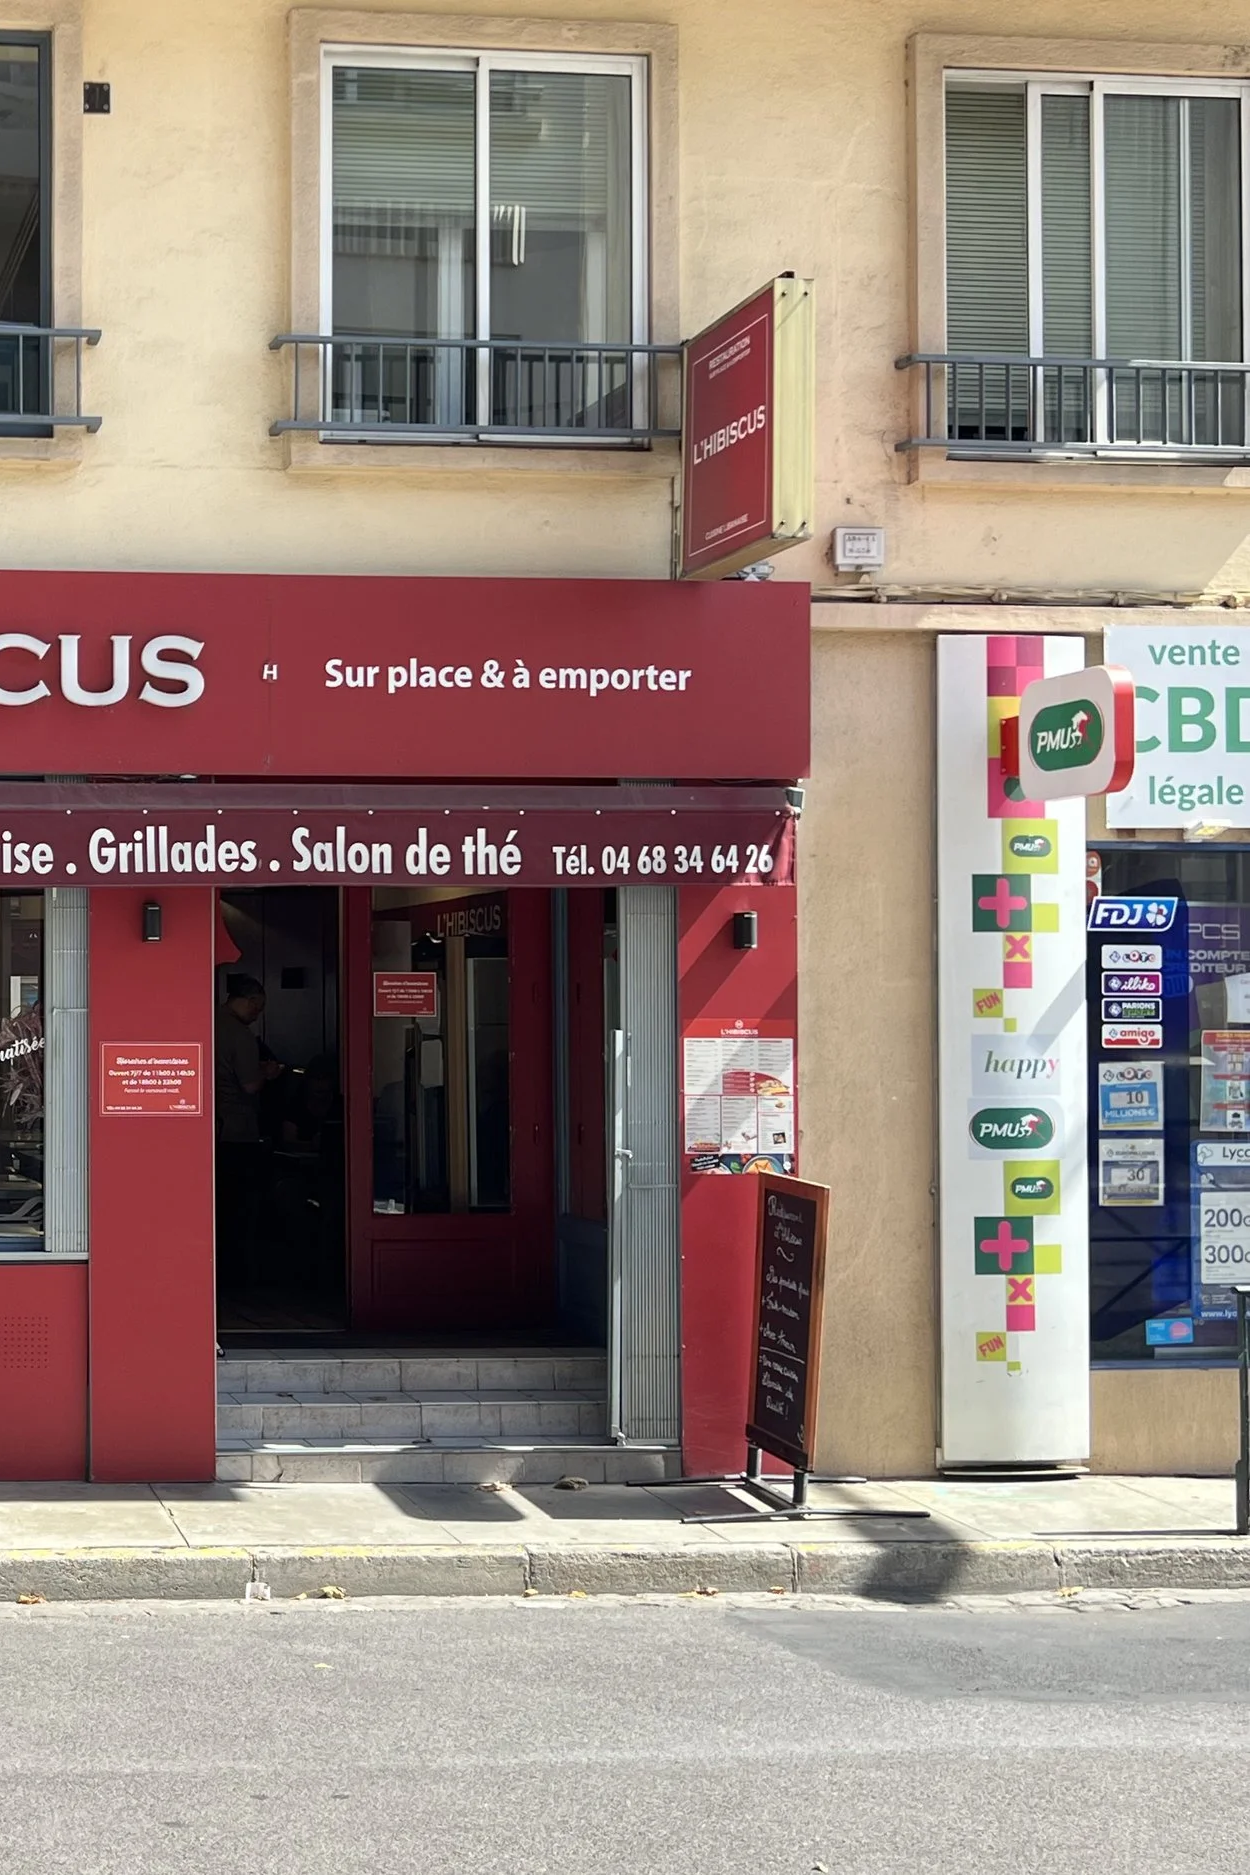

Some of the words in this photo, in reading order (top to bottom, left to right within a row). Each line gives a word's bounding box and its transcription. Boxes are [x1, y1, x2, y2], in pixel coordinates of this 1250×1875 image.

[694, 405, 765, 465] L'HIBISCUS
[1148, 639, 1240, 666] vente
[263, 665, 277, 679] H
[326, 659, 379, 687] Sur
[388, 658, 472, 693] place
[481, 660, 505, 687] &
[513, 660, 529, 688] à
[539, 666, 691, 696] emporter
[1036, 728, 1070, 755] PMU
[1149, 775, 1244, 812] légale
[292, 826, 391, 873] Salon
[406, 828, 450, 874] de
[462, 828, 521, 875] thé
[553, 845, 594, 874] Tél.
[602, 846, 630, 874] 04
[638, 846, 666, 874] 68
[675, 846, 703, 873] 34
[711, 845, 738, 873] 64
[745, 845, 773, 873] 26
[438, 905, 501, 937] L'HIBISCUS
[1095, 903, 1144, 925] FDJ
[1184, 923, 1241, 940] PCS
[1188, 950, 1250, 961] COMPTE
[1120, 976, 1155, 991] illiko
[976, 991, 1001, 1015] FUN
[1122, 1002, 1155, 1010] PARIONS
[1120, 1027, 1155, 1044] amigo
[984, 1050, 1060, 1079] happy
[1126, 1091, 1144, 1104] 10
[1105, 1109, 1147, 1118] MILLIONS
[979, 1122, 1021, 1137] PMU
[1015, 1184, 1036, 1194] PMU
[978, 1335, 1005, 1358] FUN
